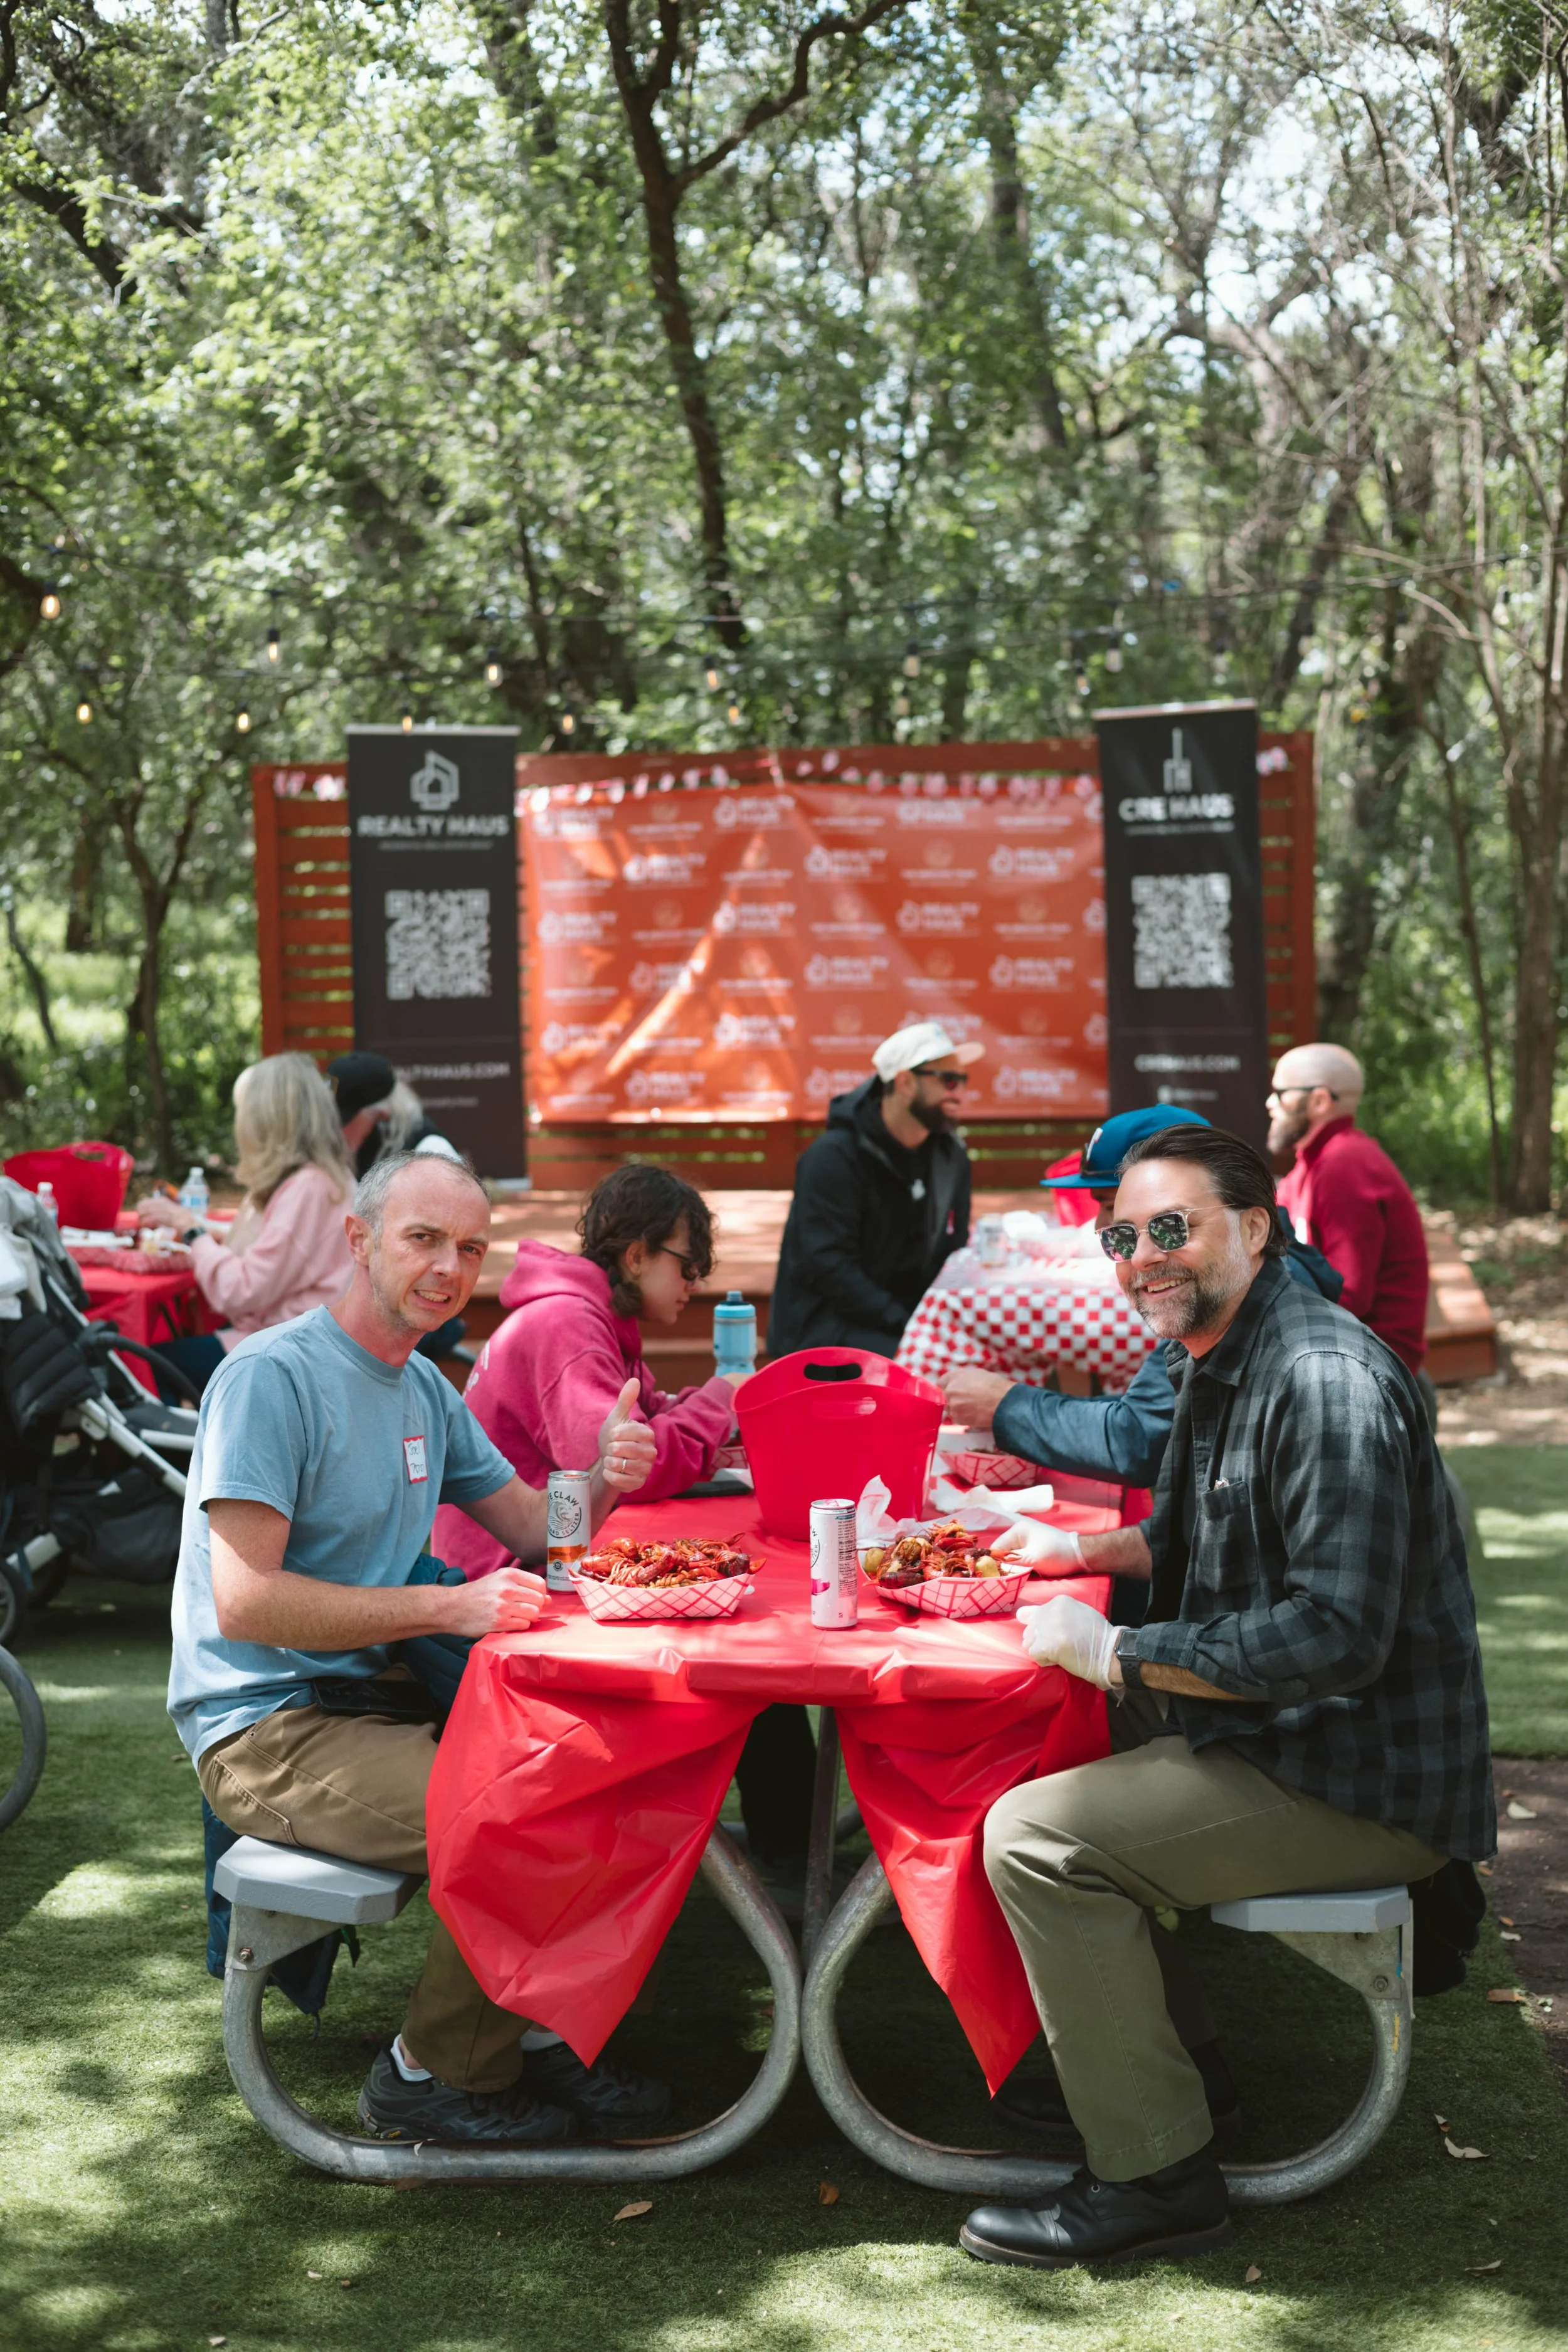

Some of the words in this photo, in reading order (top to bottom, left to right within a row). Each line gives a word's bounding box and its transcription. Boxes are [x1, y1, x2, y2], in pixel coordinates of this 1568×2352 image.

[1169, 793, 1234, 819] HAUS
[357, 815, 444, 837] REALTY
[447, 815, 509, 836] HAUS
[554, 1490, 580, 1507] CLAW
[561, 1512, 580, 1536] SELTZER
